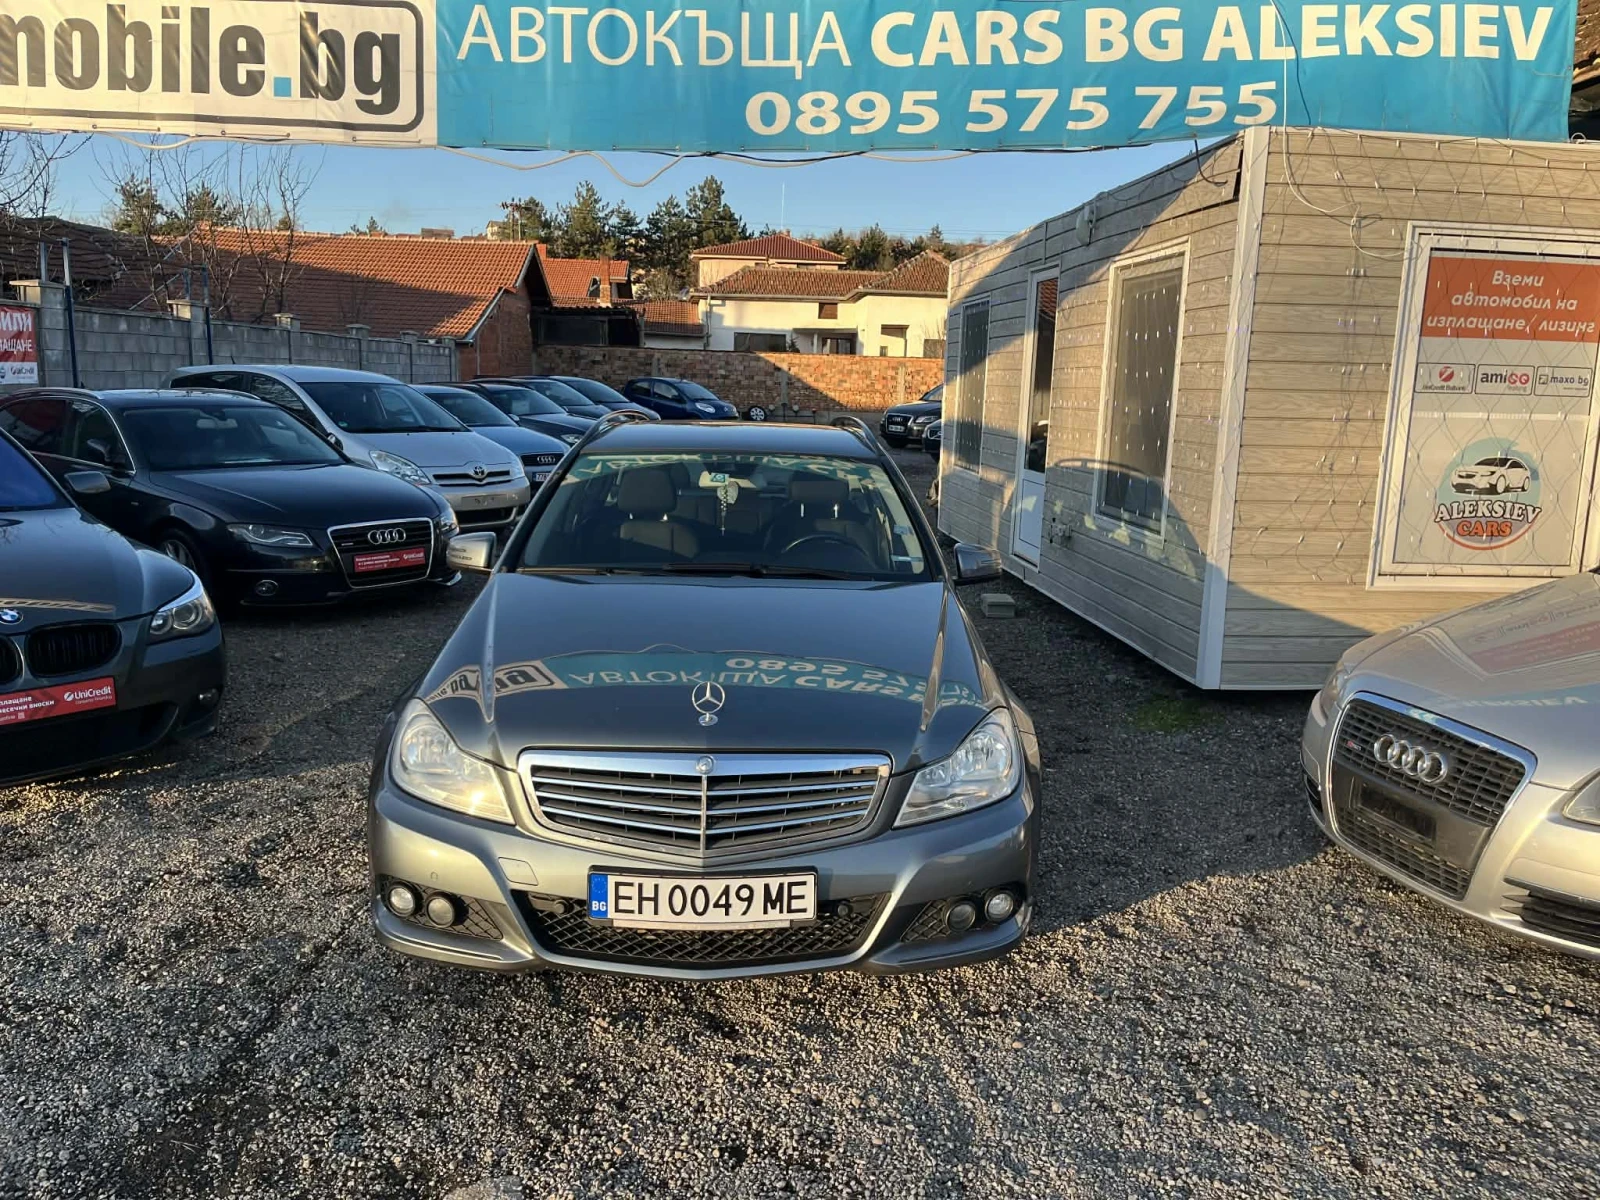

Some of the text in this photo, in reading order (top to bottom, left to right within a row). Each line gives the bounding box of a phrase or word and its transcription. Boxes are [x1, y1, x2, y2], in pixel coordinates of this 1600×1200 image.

[456, 3, 1554, 80] АВТОКЪЩА CARS BG ALEKSIEV
[0, 4, 400, 116] mobile.bg
[745, 81, 1278, 137] 0895 575 755
[1492, 270, 1544, 287] Вземи
[1451, 292, 1578, 310] автомобил на
[0, 311, 32, 331] ИЛИ
[1538, 321, 1596, 334] лизинг
[1434, 499, 1543, 524] ALEKSIEV
[1457, 521, 1513, 537] CARS
[74, 686, 112, 700] UniCredit
[592, 901, 607, 912] BG
[614, 881, 808, 917] EH 0049 ME
